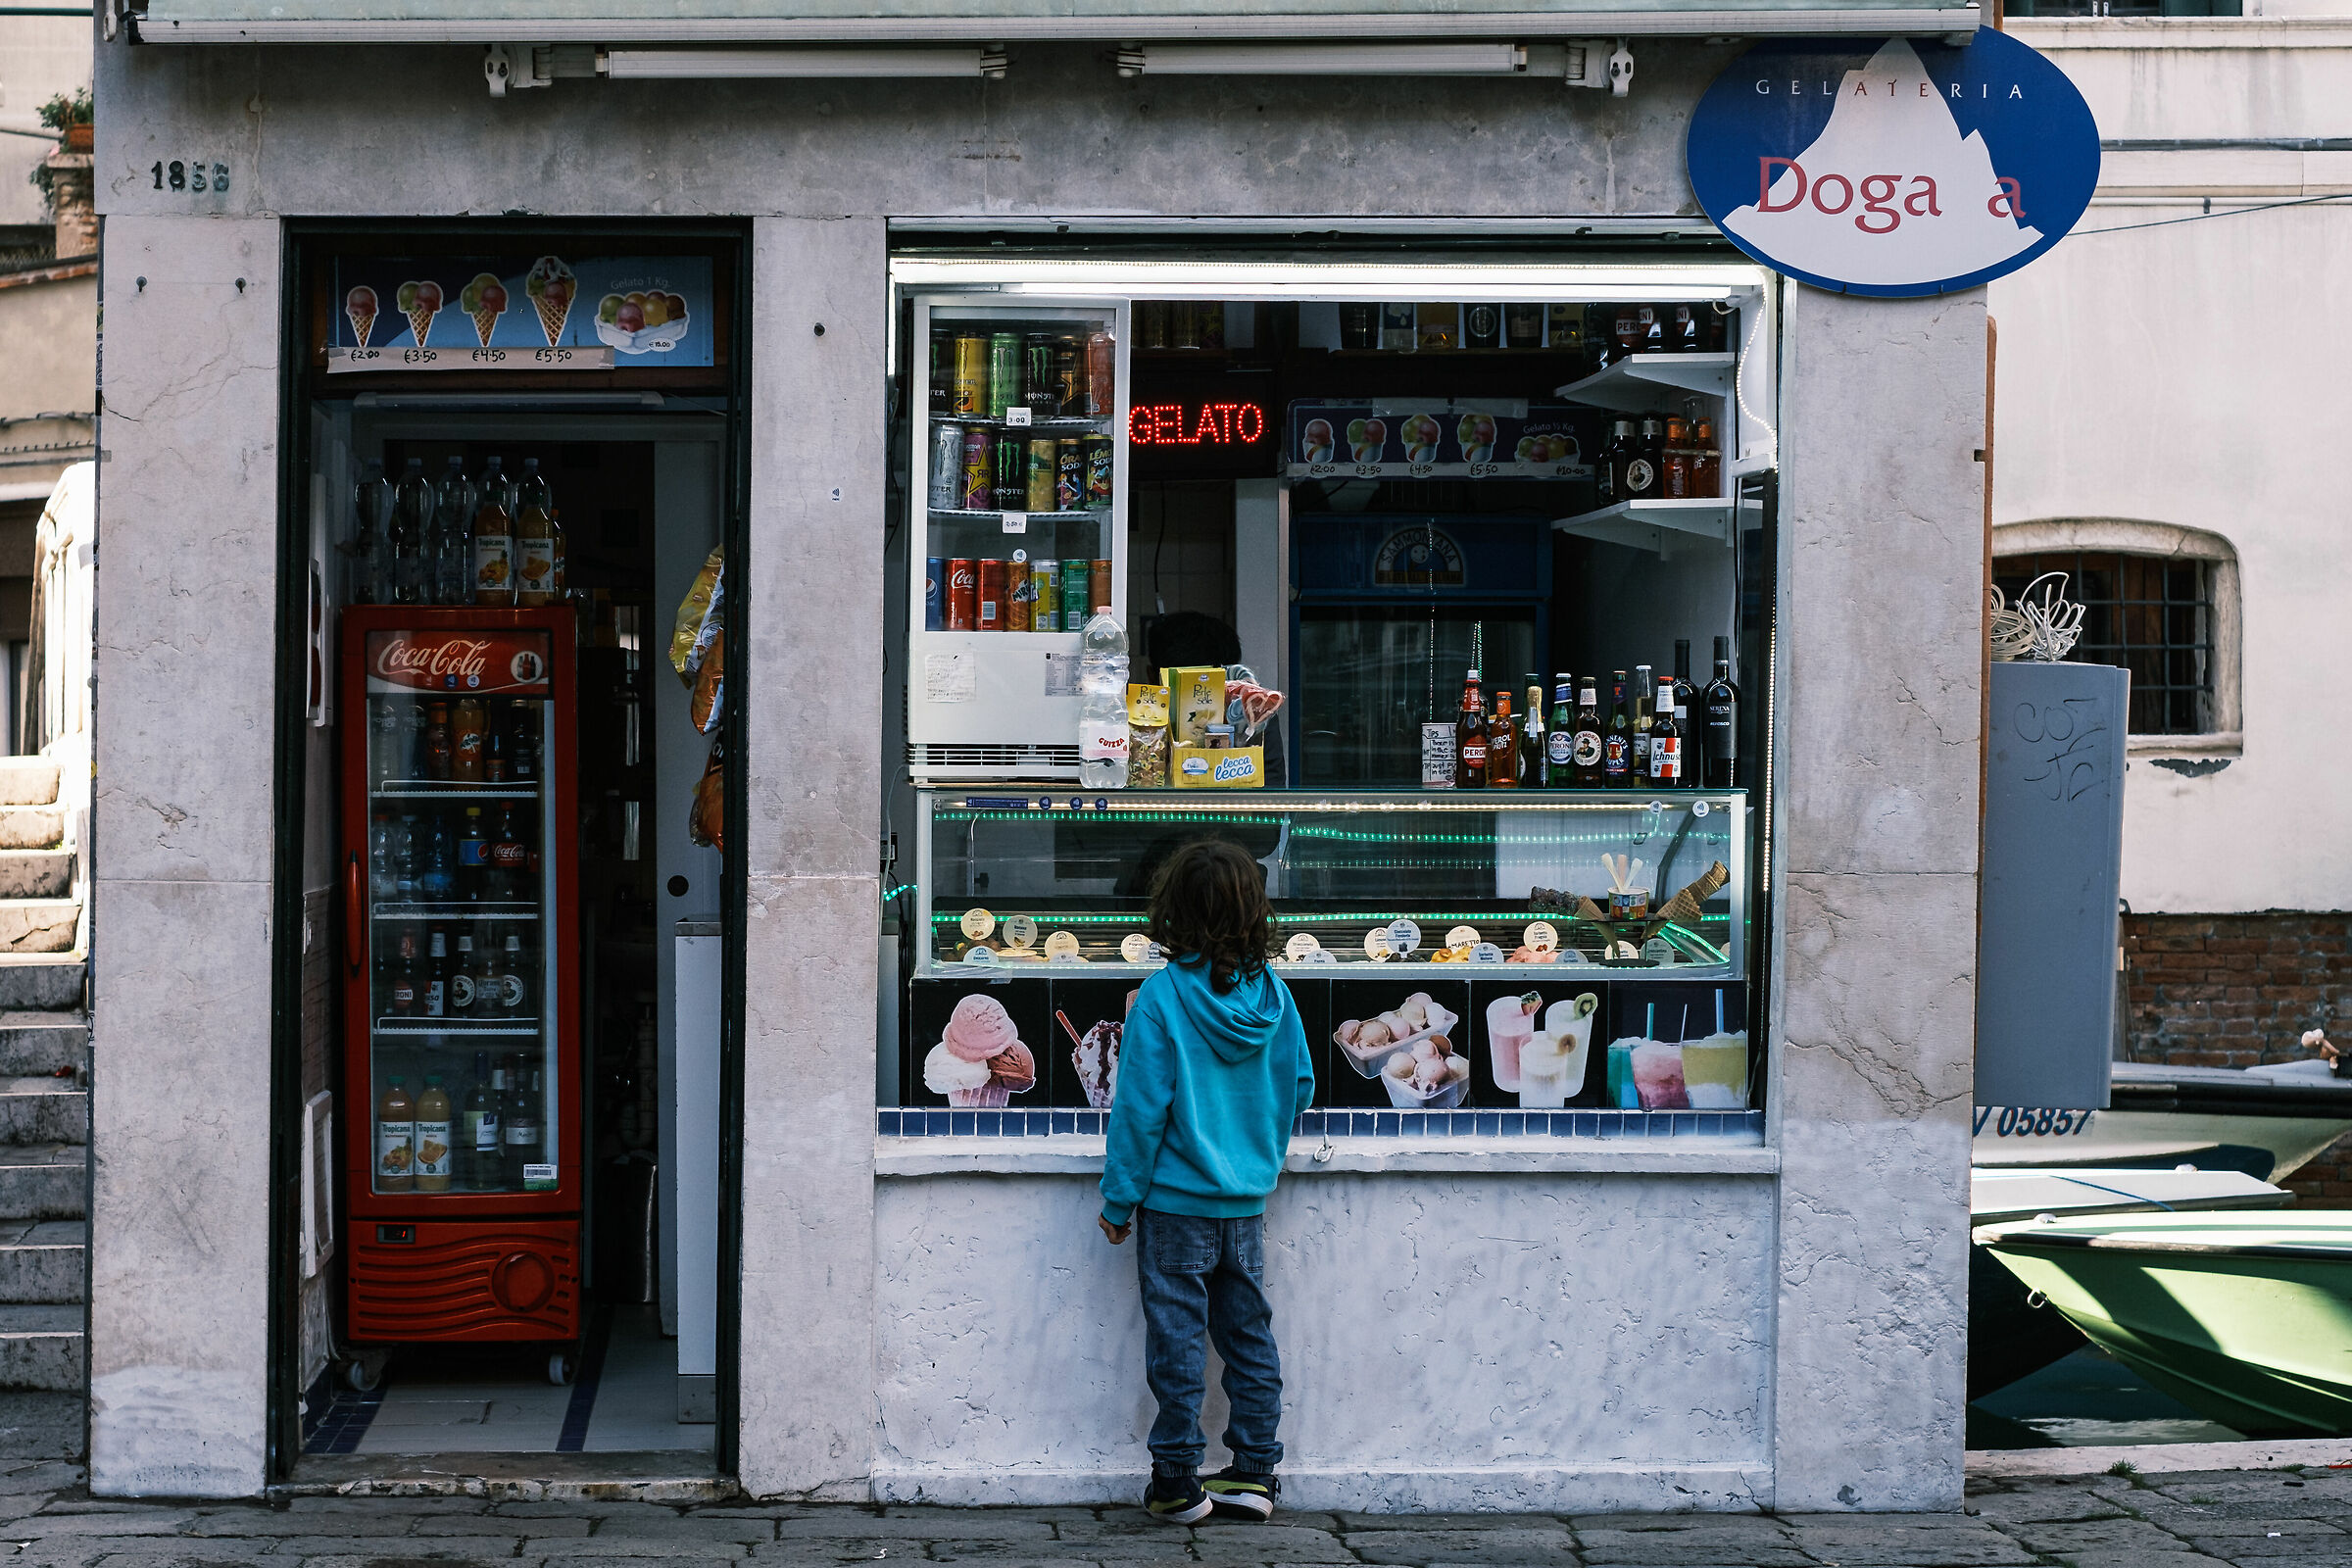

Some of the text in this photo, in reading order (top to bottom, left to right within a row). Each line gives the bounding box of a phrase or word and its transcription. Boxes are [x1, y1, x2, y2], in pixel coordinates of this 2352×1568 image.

[1755, 78, 2024, 99] GELATERIA
[611, 276, 644, 290] Gelato
[1128, 403, 1263, 444] GELATO
[1522, 423, 1551, 434] Gelato
[376, 638, 494, 677] Coca-Cola
[1099, 737, 1125, 748] GUIZZA
[1223, 756, 1251, 769] lecca
[1215, 763, 1254, 781] lecca
[382, 1123, 412, 1134] Tropicana
[417, 1123, 447, 1134] Tropicana
[1996, 1106, 2093, 1137] 05857
